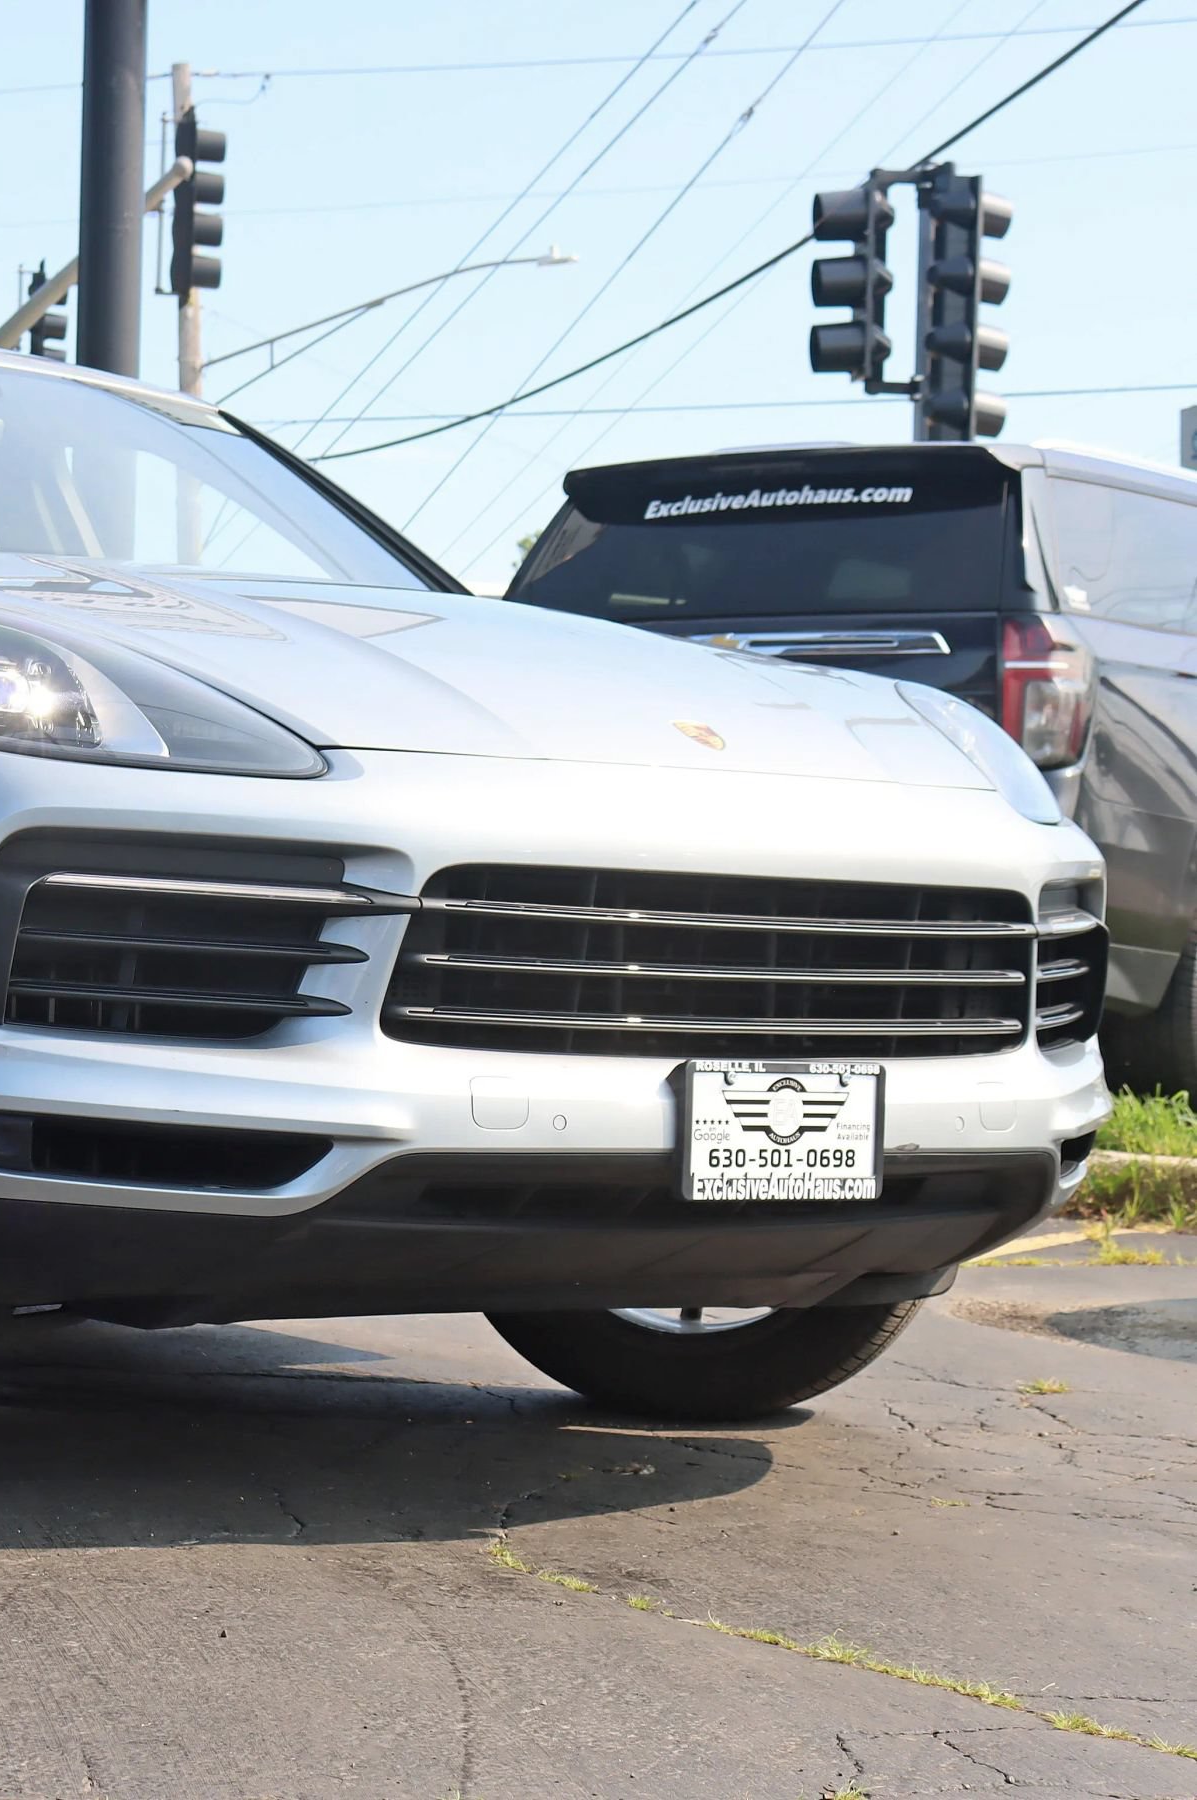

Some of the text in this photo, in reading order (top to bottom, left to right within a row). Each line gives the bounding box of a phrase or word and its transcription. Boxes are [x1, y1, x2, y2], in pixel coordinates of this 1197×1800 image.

[644, 485, 913, 520] ExclusiveAutohaus.com
[693, 1127, 731, 1144] Google
[836, 1122, 871, 1132] Financing
[708, 1148, 856, 1168] 630-501-0698
[692, 1174, 877, 1200] ExclusiveAutoHaus.com
